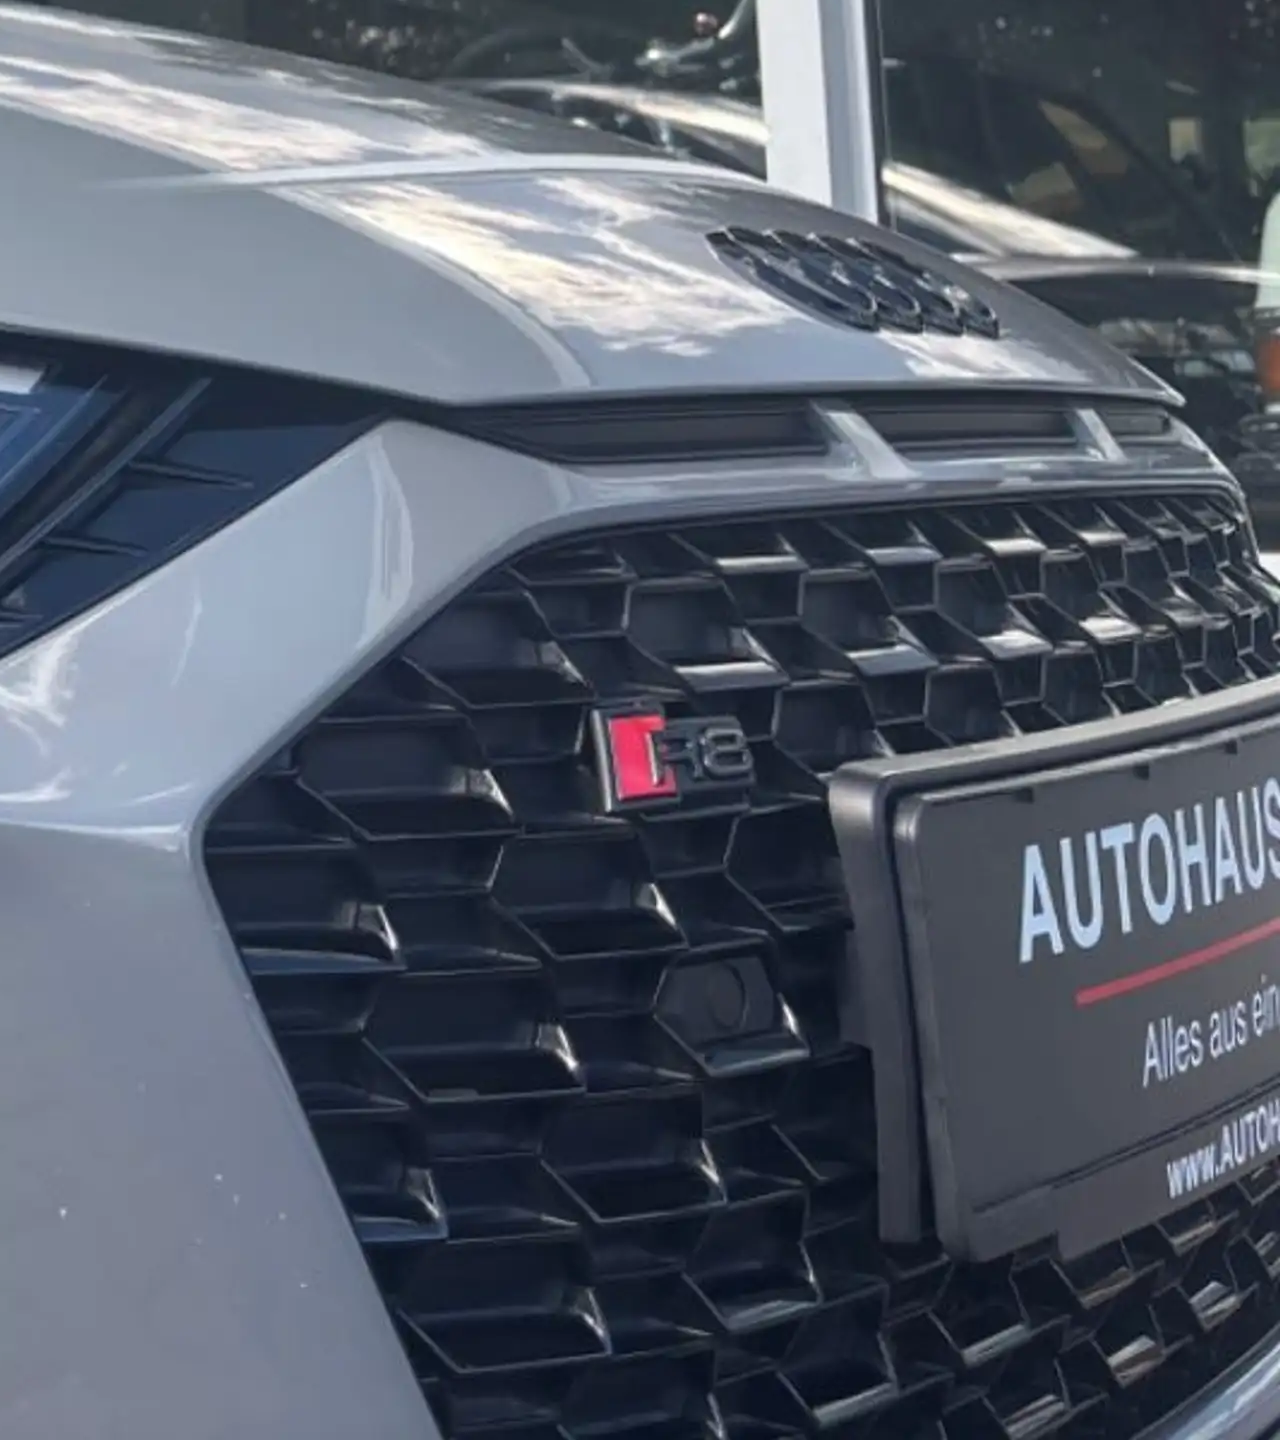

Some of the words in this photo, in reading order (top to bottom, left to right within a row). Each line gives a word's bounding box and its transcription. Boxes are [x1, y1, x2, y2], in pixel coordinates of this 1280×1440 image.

[1020, 777, 1280, 963] AUTOHAUS
[1143, 1016, 1204, 1088] Alles
[1209, 1000, 1248, 1059] aus
